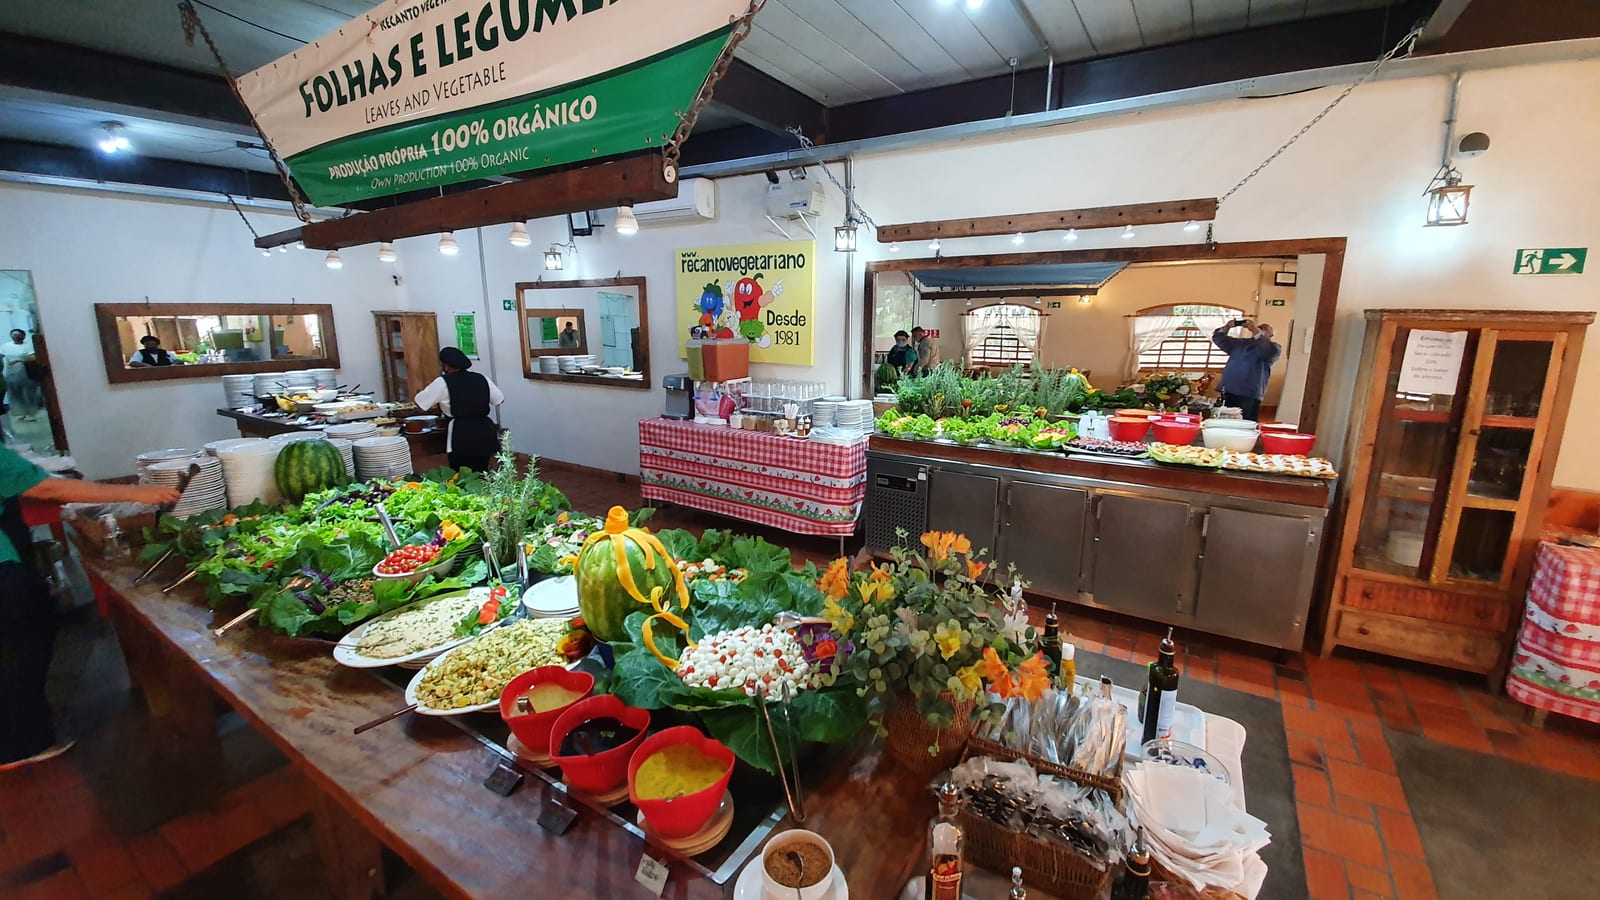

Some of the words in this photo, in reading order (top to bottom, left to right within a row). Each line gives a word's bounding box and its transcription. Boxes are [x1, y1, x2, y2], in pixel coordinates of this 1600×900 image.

[380, 6, 419, 31] RECANTO
[299, 43, 402, 118] FOLHAS
[410, 32, 427, 78] E
[436, 0, 618, 68] LEGUM
[365, 98, 400, 124] LEAVES
[404, 89, 430, 112] AND
[433, 62, 506, 100] VEGETABLE
[329, 153, 378, 180] PRODUÇÃO
[379, 142, 428, 167] PRÓPRIA
[431, 118, 490, 156] 100%
[493, 95, 598, 141] ORGÂNICO
[370, 176, 391, 190] OWN
[393, 164, 447, 186] PRODUCTION
[450, 157, 479, 174] 100%
[481, 147, 529, 169] ORGANIC
[681, 253, 806, 276] recantovegetariano
[766, 309, 807, 327] Desde
[774, 330, 801, 346] 1981
